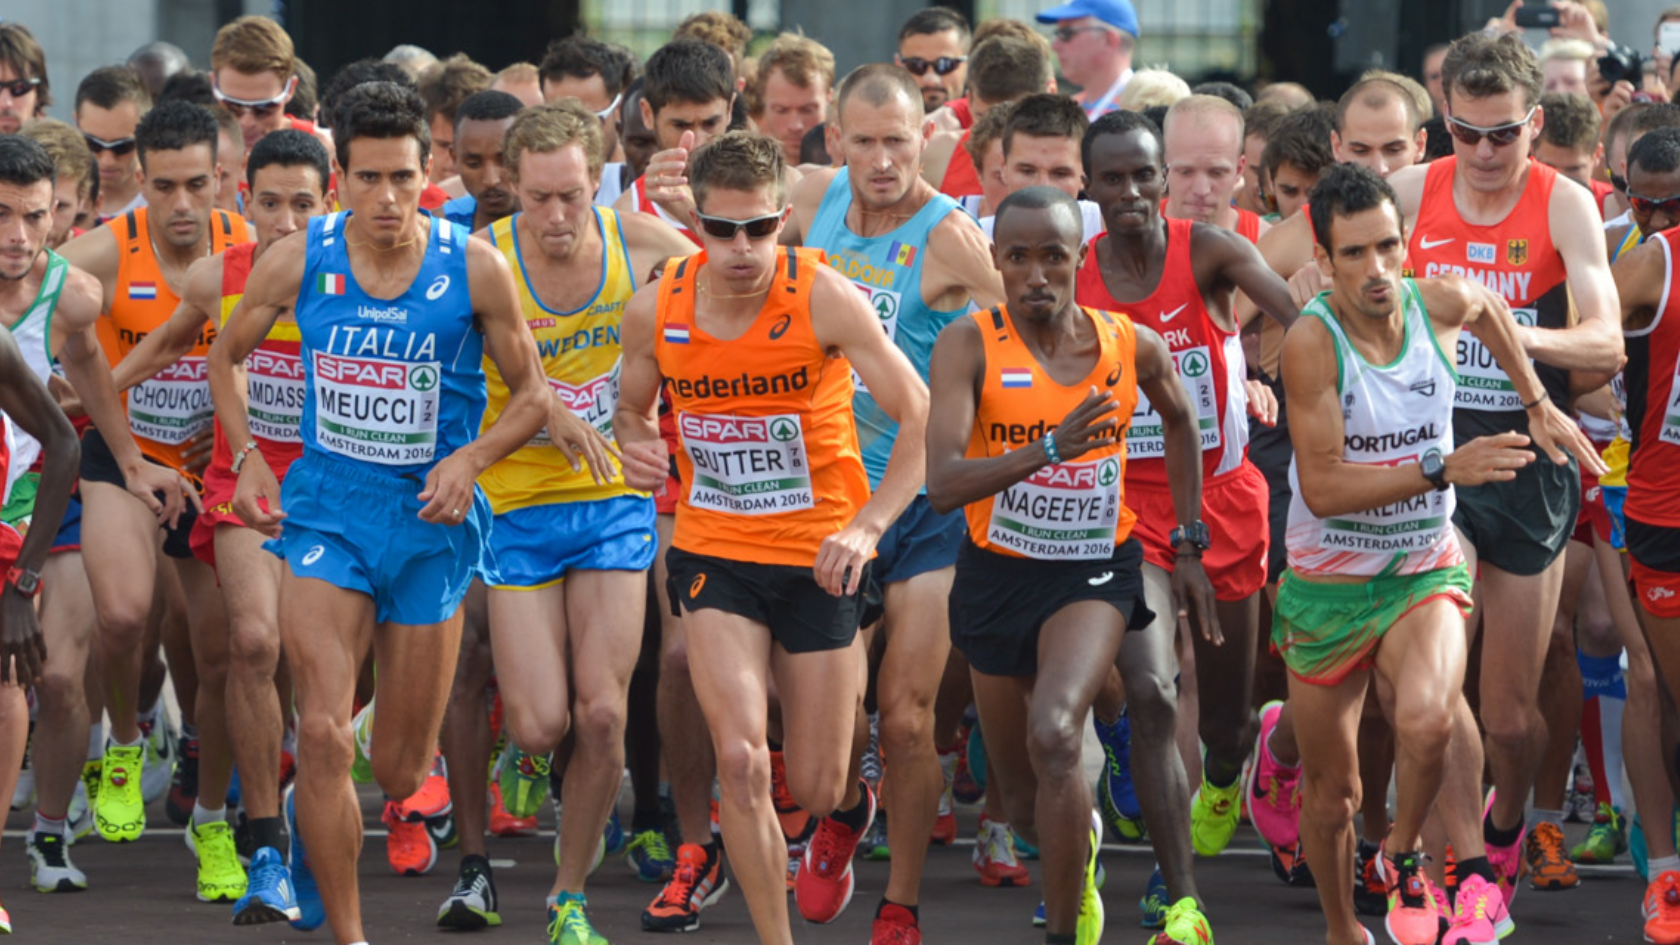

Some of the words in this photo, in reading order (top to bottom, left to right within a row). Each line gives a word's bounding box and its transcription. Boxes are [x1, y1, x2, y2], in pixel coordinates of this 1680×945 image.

[1468, 245, 1494, 260] DKB
[827, 253, 895, 289] OLDOVA
[326, 325, 436, 361] ITALIA
[536, 325, 621, 358] WEDEN
[318, 356, 405, 387] SPAR
[663, 366, 809, 399] nederland
[1467, 377, 1503, 390] CLEAN
[133, 384, 212, 411] CHOUKOU
[320, 385, 415, 425] MEUCCI
[1499, 394, 1523, 407] 201
[345, 427, 368, 440] RUN
[370, 432, 407, 443] CLEAN
[683, 416, 767, 440] SPAR
[319, 431, 400, 460] AMSTERDAM
[403, 446, 433, 460] 2016
[690, 446, 785, 477] BUTTER
[744, 480, 780, 493] CLEAN
[1030, 465, 1095, 487] PAR
[693, 489, 777, 510] AMSTERDAM
[780, 491, 811, 507] 2016
[1000, 488, 1102, 522] NAGEEYE
[1027, 526, 1051, 539] RUN
[1053, 530, 1088, 540] CLEAN
[1360, 524, 1383, 535] RUN
[1385, 521, 1419, 534] CLEAN
[991, 529, 1080, 555] AMSTERDAM
[1083, 542, 1111, 555] 2016
[1323, 532, 1414, 550] AMSTERDAM
